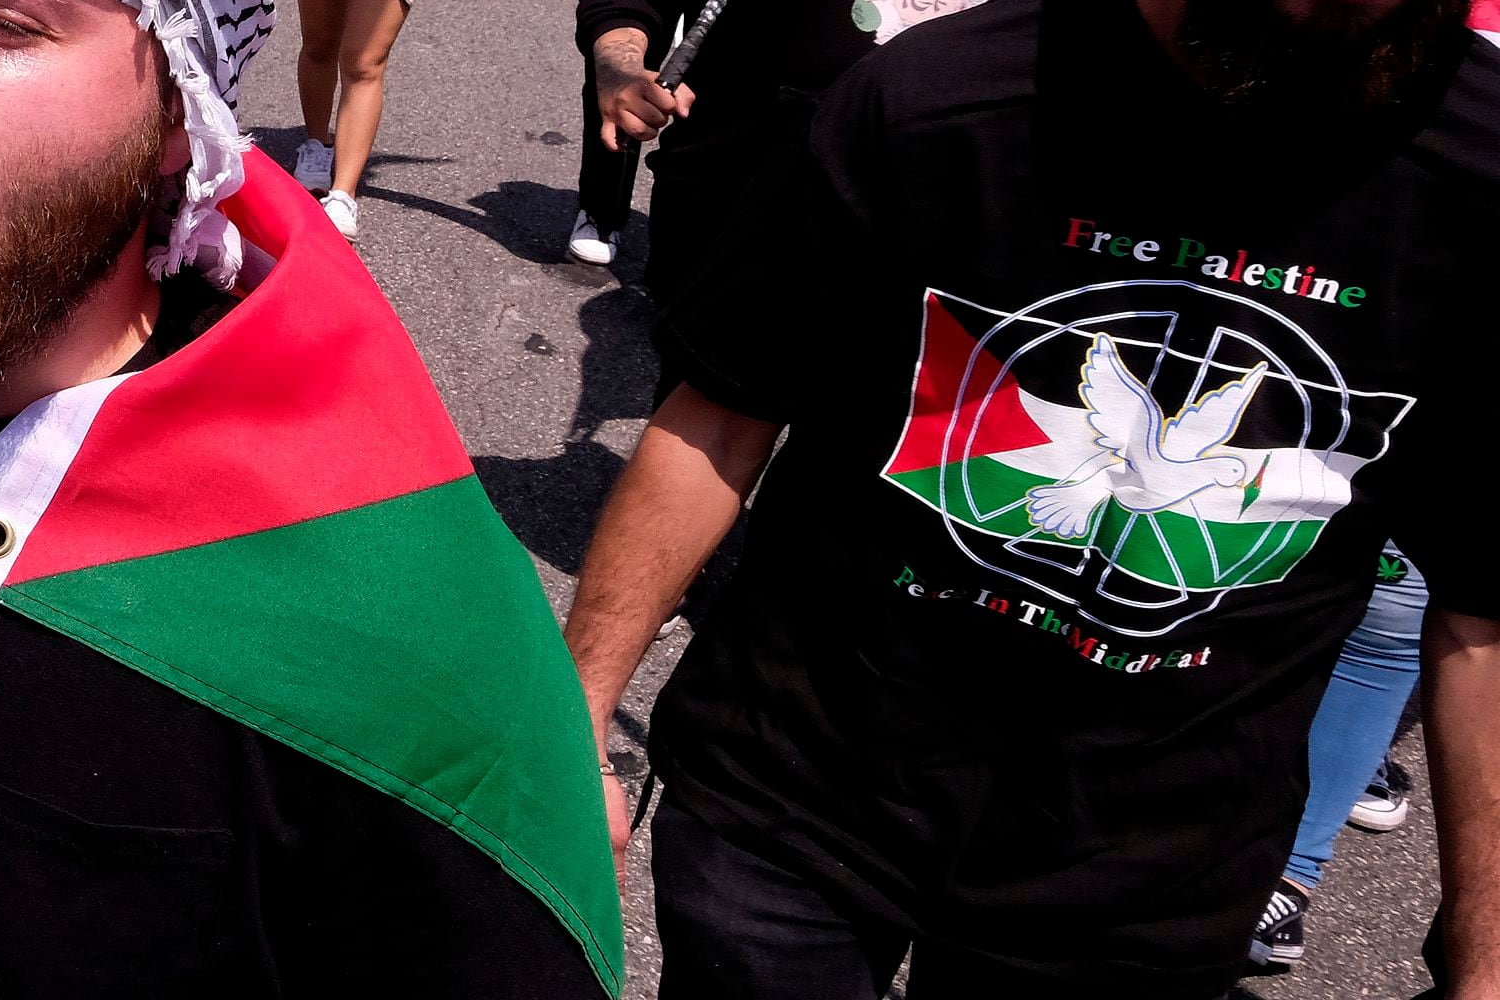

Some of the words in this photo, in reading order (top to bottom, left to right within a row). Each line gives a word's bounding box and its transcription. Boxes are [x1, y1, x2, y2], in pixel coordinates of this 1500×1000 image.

[1063, 217, 1161, 262] Free
[1170, 237, 1367, 308] Palestine
[893, 565, 967, 600] Pec
[973, 588, 1009, 615] In
